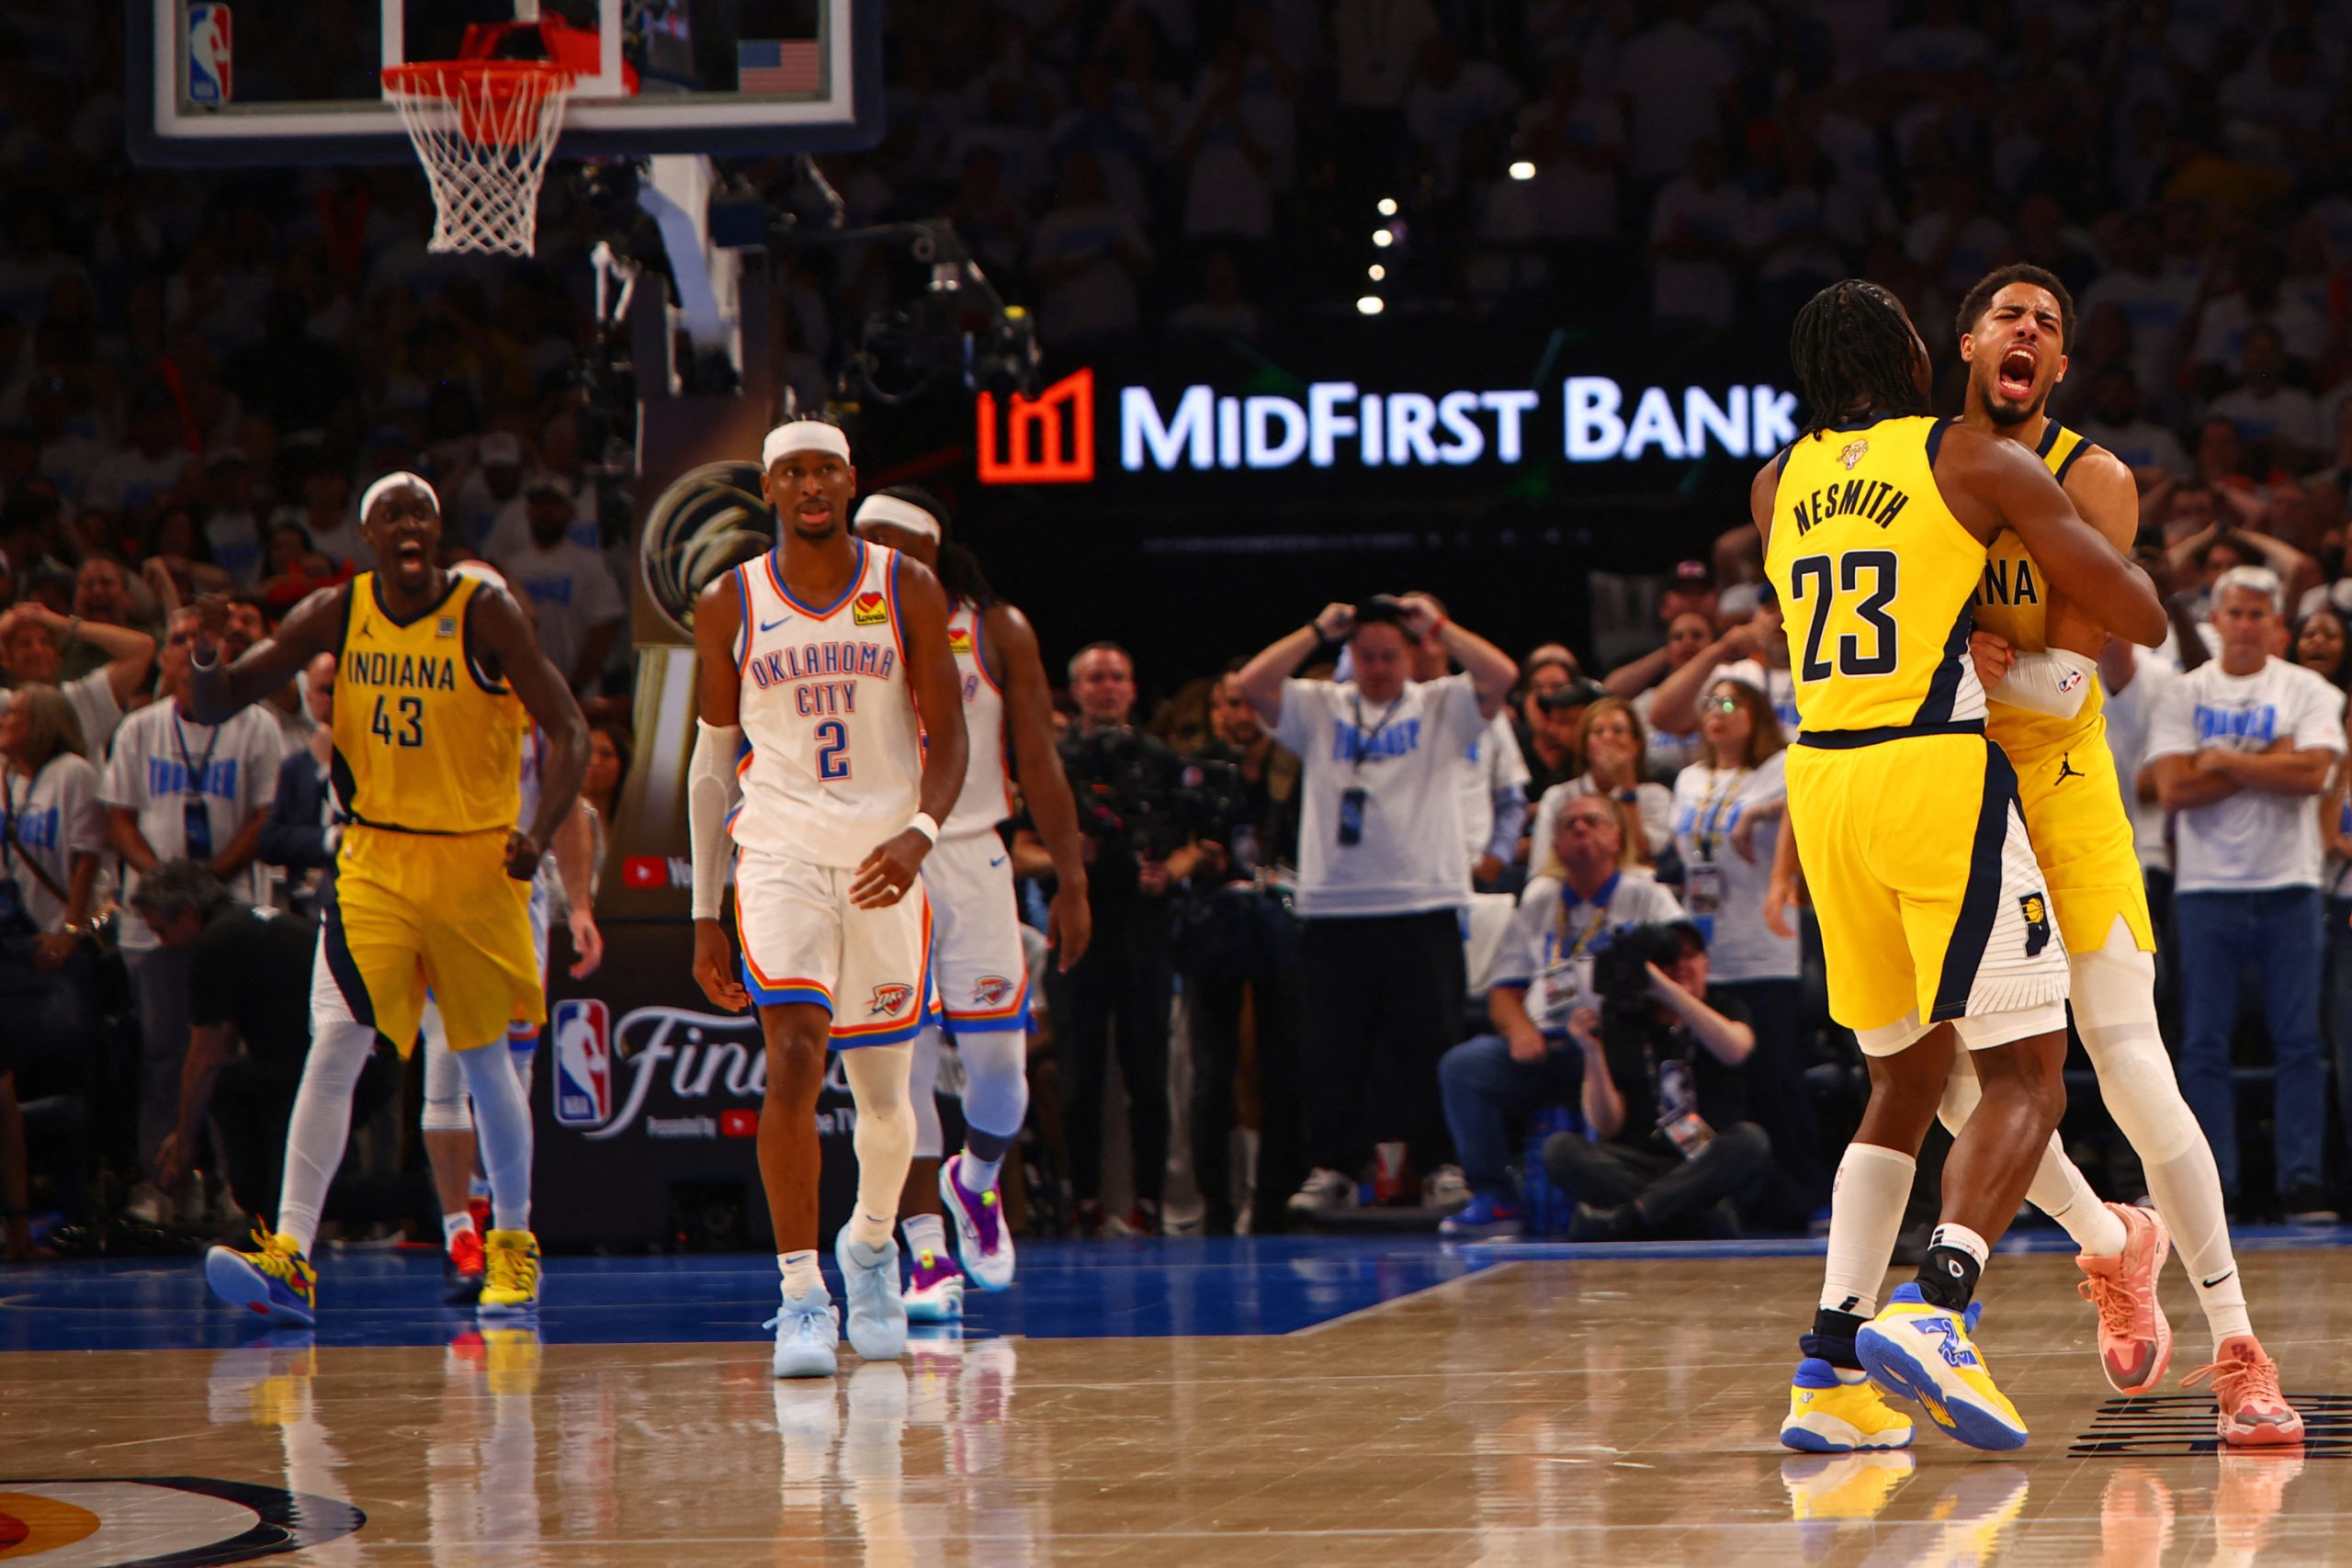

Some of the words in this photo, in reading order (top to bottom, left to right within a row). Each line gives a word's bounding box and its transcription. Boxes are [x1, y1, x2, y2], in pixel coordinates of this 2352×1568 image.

[1792, 479, 1909, 537] NESMITH
[1791, 548, 1898, 682] 23
[347, 650, 456, 692] INDIANA
[750, 641, 897, 690] OKLAHOMA
[372, 694, 424, 747] 43
[795, 680, 857, 716] CITY
[814, 717, 852, 782] 2
